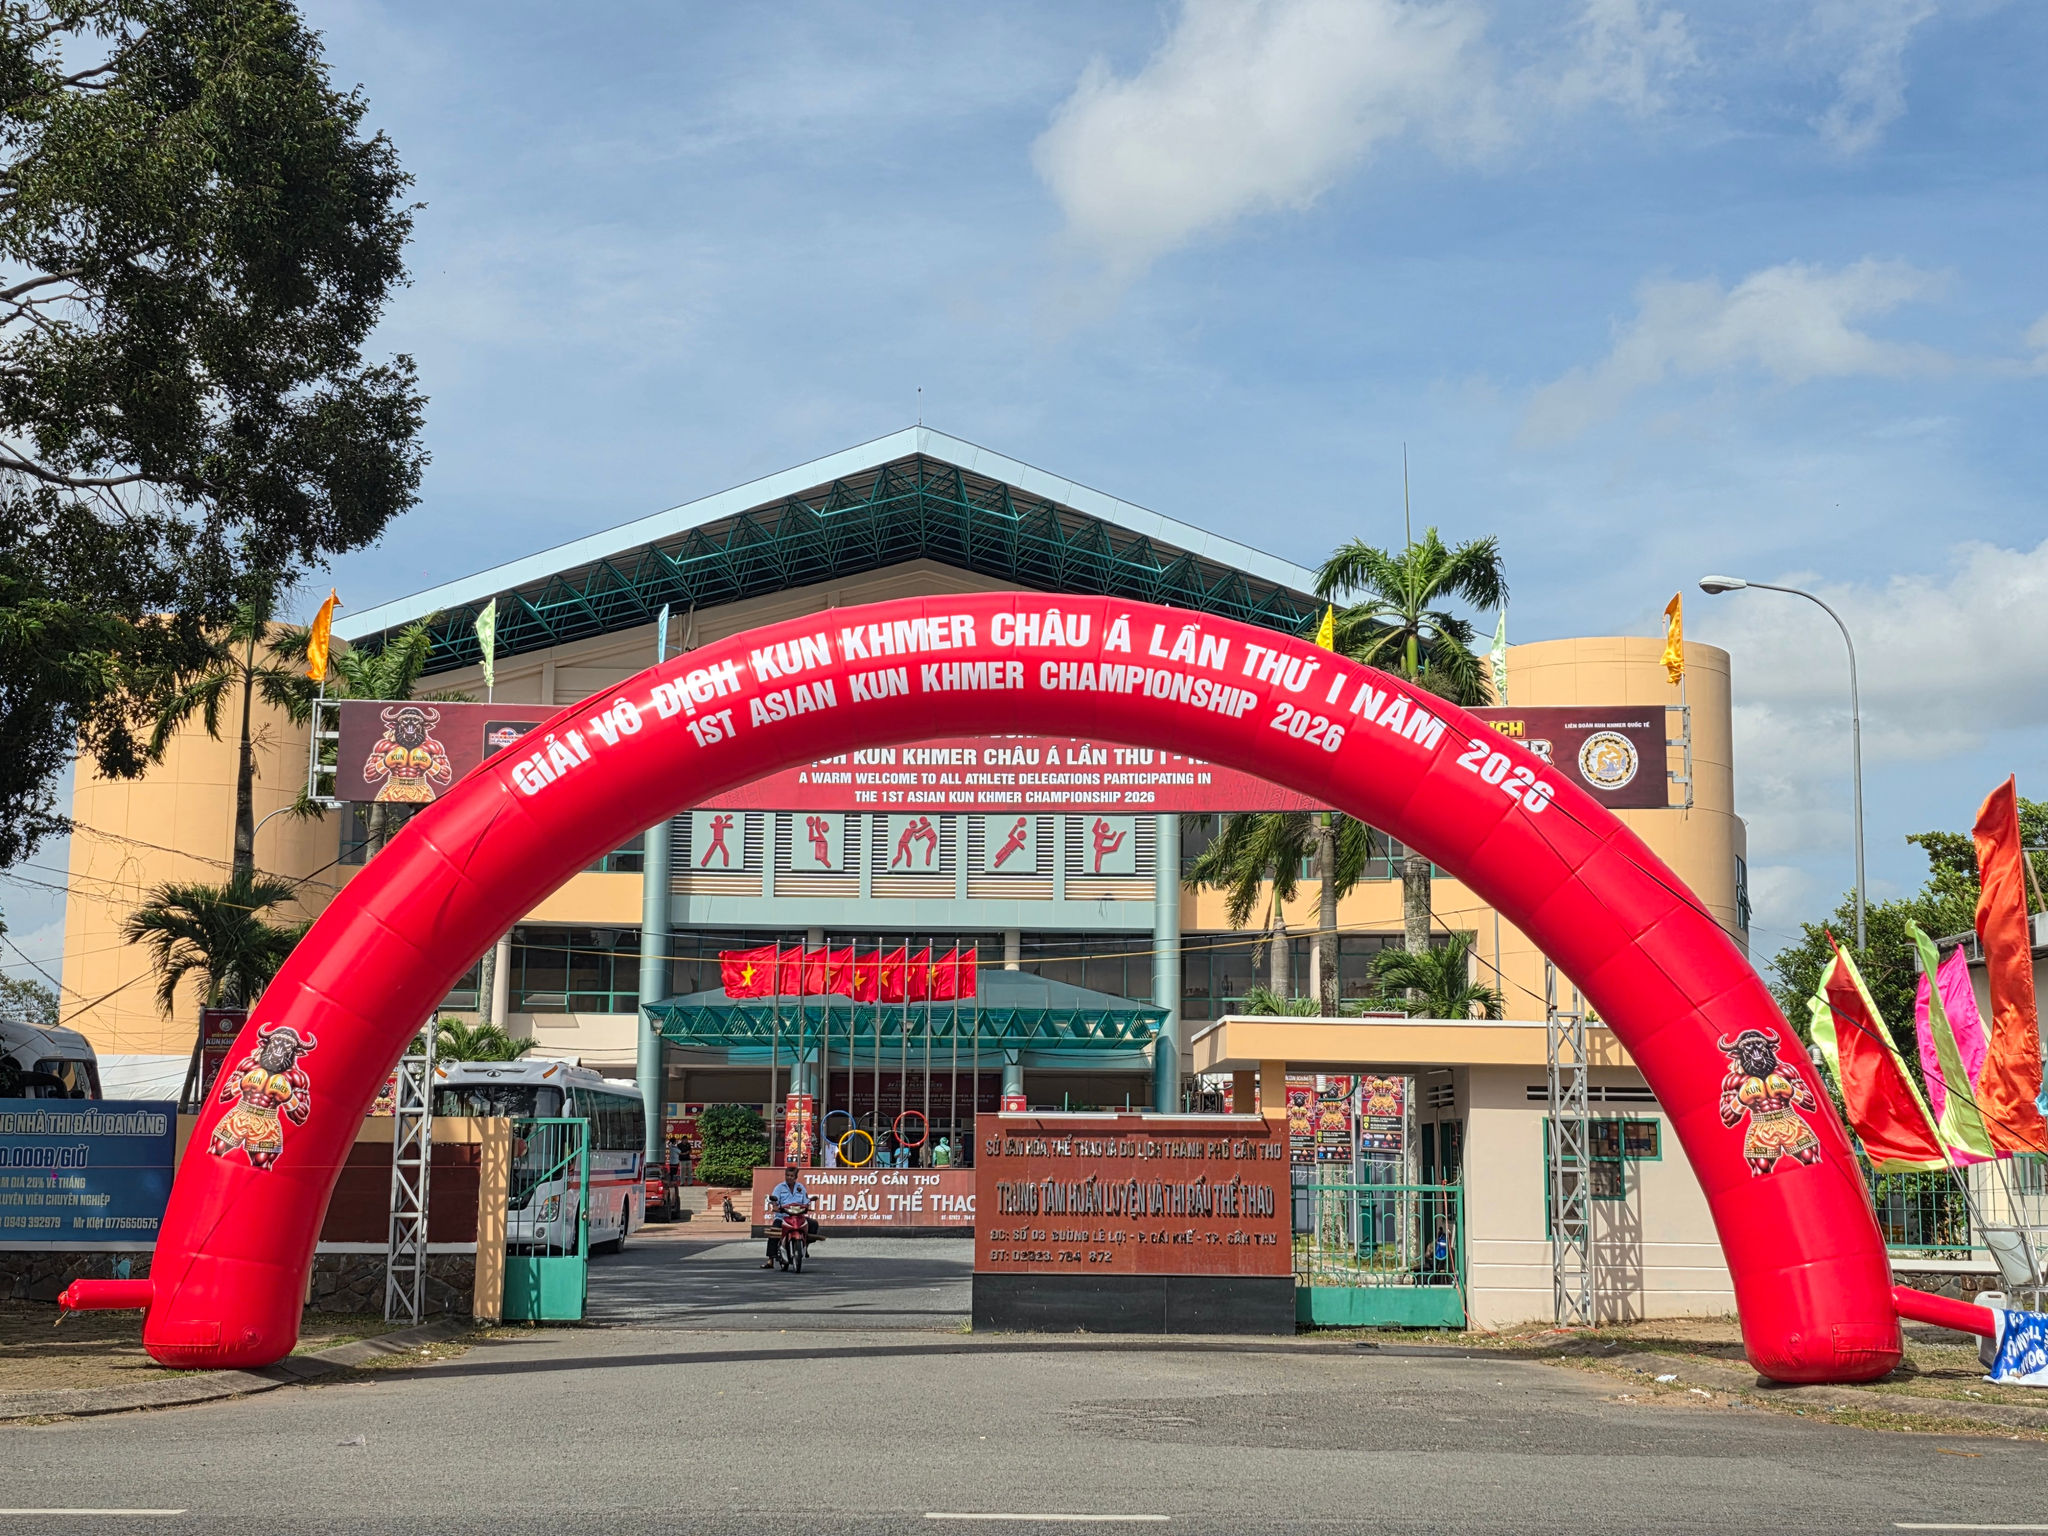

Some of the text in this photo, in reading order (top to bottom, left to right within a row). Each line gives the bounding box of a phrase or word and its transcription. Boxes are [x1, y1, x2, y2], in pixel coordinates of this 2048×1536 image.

[512, 734, 591, 796] GIẢI
[591, 697, 643, 746] VÔ
[650, 659, 742, 719] ĐỊCH
[751, 633, 832, 682] KUN
[841, 614, 976, 661] KHMER
[991, 608, 1090, 647] CHÂU
[1104, 614, 1131, 653] Á
[1149, 624, 1230, 671] LẦN
[1241, 643, 1320, 693] THỨ
[1325, 672, 1347, 704] I
[1349, 683, 1448, 750] NĂM
[1456, 738, 1555, 813] 2026
[686, 661, 1346, 753] 1ST ASIAN KUN KHMER CHAMPIONSHIP 2026
[390, 754, 405, 762] KUN
[853, 748, 896, 766] KUN
[902, 748, 977, 766] KHMER
[984, 746, 1039, 766] CHÂU
[1045, 745, 1060, 766] Á
[1066, 743, 1107, 766] LẦN
[799, 772, 1211, 785] A WARM WELCOME TO ALL ATHLETE DELEGATIONS PARTICIPATING IN
[855, 791, 1155, 803] THE 1ST ASIAN KUN KHMER CHAMPIONSHIP 2026
[248, 1075, 289, 1095] KUN KHMER
[1745, 1082, 1788, 1096] KUN KHMER
[16, 1111, 46, 1134] NHÀ
[49, 1115, 71, 1134] THI
[74, 1109, 103, 1134] ĐẤU
[105, 1115, 124, 1134] ĐA
[127, 1112, 166, 1134] NĂNG
[986, 1133, 1001, 1156] SỞ
[1052, 1133, 1072, 1157] THỂ
[1075, 1140, 1102, 1157] THAO
[1105, 1137, 1118, 1157] VÀ
[1120, 1140, 1135, 1158] DU
[1138, 1141, 1162, 1161] LỊCH
[1165, 1140, 1204, 1159] THÀNH
[1208, 1137, 1231, 1159] PHỐ
[1233, 1138, 1257, 1159] CẦN
[26, 1176, 44, 1188] 20%
[58, 1175, 86, 1189] THÁNG
[804, 1171, 940, 1185] THÀNH PHỐ CẦN THƠ
[45, 1192, 79, 1206] CHUYÊN
[80, 1193, 110, 1207] NGHIỆP
[843, 1189, 880, 1212] ĐẤU
[887, 1187, 923, 1212] THỂ
[996, 1172, 1274, 1219] TRUNG TÂM HUẤN LUYỆN VÀ THI ĐẤU THỂ THAO
[3, 1216, 27, 1228] 0949
[28, 1216, 61, 1228] 392979
[73, 1217, 85, 1228] Mr
[105, 1217, 158, 1230] 0775650575
[1013, 1226, 1029, 1242] SỐ
[1031, 1229, 1046, 1242] 03
[1093, 1228, 1106, 1243] LÊ
